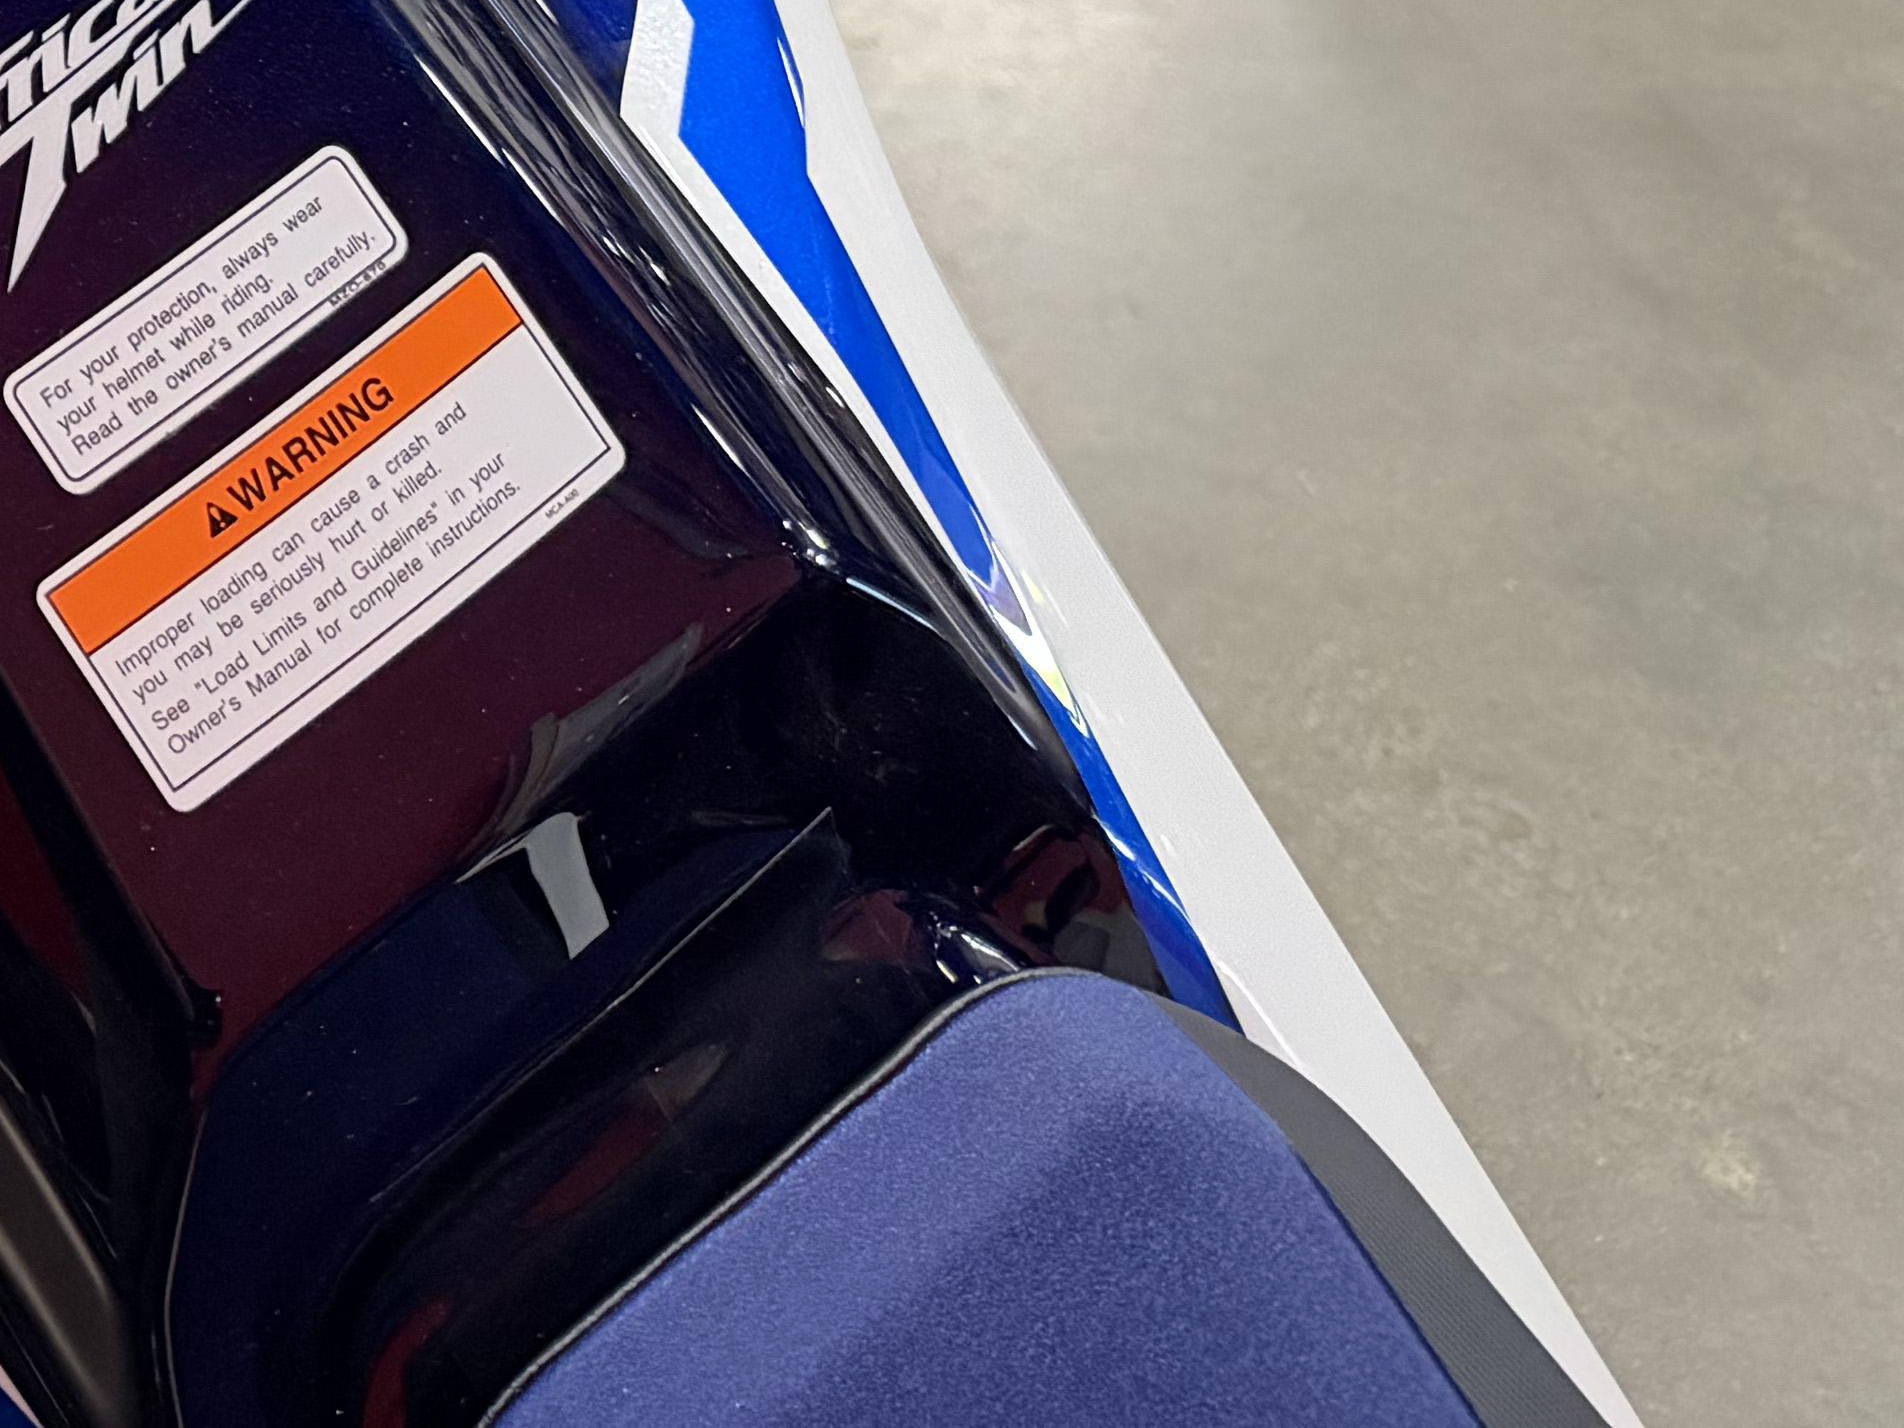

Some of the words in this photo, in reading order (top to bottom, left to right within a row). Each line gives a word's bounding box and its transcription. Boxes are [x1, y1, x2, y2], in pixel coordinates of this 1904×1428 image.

[38, 377, 73, 408] For
[78, 344, 120, 386] your
[126, 281, 218, 353] protection,
[221, 231, 279, 280] always
[281, 195, 322, 232] wear
[55, 395, 97, 437] your
[101, 346, 166, 399] helmet
[168, 312, 216, 351] while
[220, 273, 273, 315] riding.
[70, 410, 124, 456] Read
[126, 388, 159, 416] the
[164, 335, 232, 390] owner's
[235, 281, 299, 338] manual
[303, 230, 375, 288] carefully.
[113, 611, 195, 677] Improper
[198, 560, 268, 614] loading
[271, 531, 305, 562] can
[309, 488, 361, 533] cause
[366, 473, 381, 490] a
[384, 434, 430, 475] crash
[434, 400, 467, 436] and
[224, 376, 395, 512] WARNING
[131, 669, 168, 706] you
[173, 635, 213, 671] may
[215, 613, 244, 638] be
[249, 551, 325, 615] seriously
[327, 518, 367, 553] hurt
[370, 500, 389, 522] or
[391, 459, 442, 504] killed.
[150, 697, 190, 731] See
[193, 649, 250, 694] "Load
[251, 610, 307, 656] Limits
[312, 575, 348, 612] and
[350, 500, 438, 581] Guidelines"
[446, 486, 466, 506] in
[468, 452, 504, 493] your
[167, 695, 242, 754] Owner's
[244, 638, 313, 697] Manual
[315, 617, 342, 644] for
[348, 556, 424, 620] complete
[428, 480, 520, 558] instructions.
